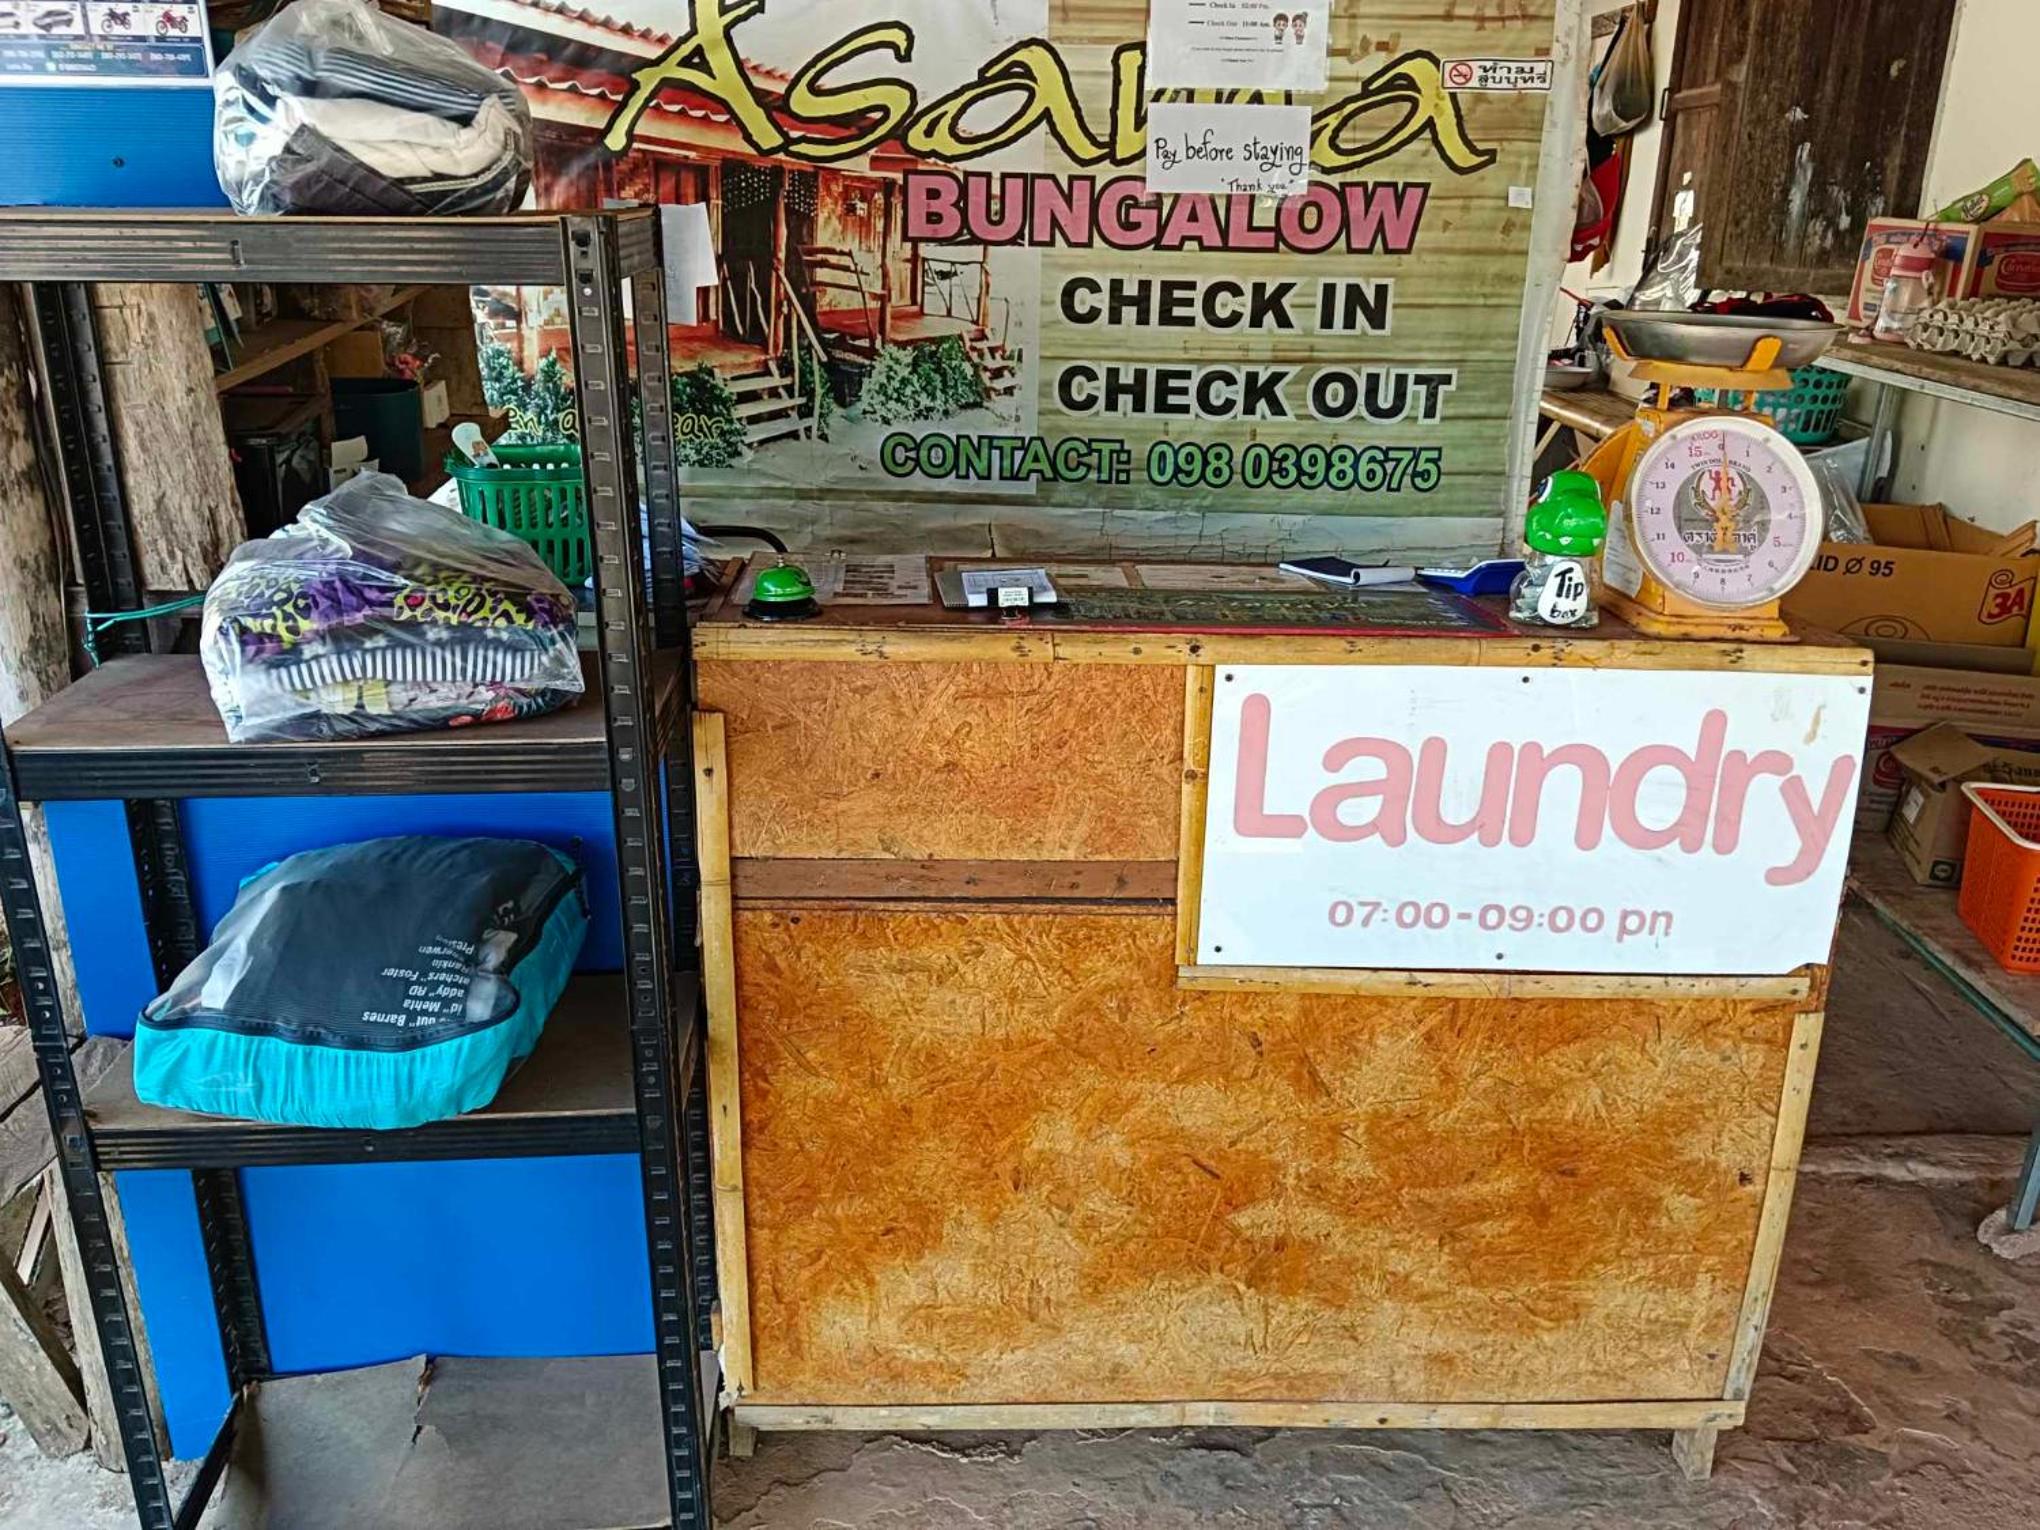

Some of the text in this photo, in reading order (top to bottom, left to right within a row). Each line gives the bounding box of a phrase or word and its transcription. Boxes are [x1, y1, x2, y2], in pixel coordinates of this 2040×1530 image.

[1478, 61, 1535, 74] ห้าม
[1478, 71, 1547, 87] สูบบุหรี่
[1154, 128, 1308, 176] Pay before staying
[902, 170, 1431, 254] BUNGALOW
[1059, 277, 1390, 331] CHECK IN
[1057, 365, 1455, 420] CHECK OUT
[1688, 445, 1703, 457] 15
[880, 432, 1442, 492] CONTACT: 098 0398675
[1664, 461, 1675, 470] 14
[1765, 465, 1773, 473] 2
[1654, 481, 1666, 490] 13
[1650, 507, 1661, 515] 12
[1655, 532, 1666, 541] 11
[1772, 536, 1782, 548] 5
[1669, 552, 1685, 563] 10
[1868, 559, 1896, 578] 95
[1554, 566, 1585, 601] Tip
[1719, 577, 1726, 586] 8
[1549, 602, 1578, 618] box
[1986, 587, 2026, 620] 3A
[1233, 692, 1857, 887] Laundry
[381, 967, 419, 981] Foster
[403, 998, 441, 1012] Mehta
[362, 1010, 407, 1026] Barnes
